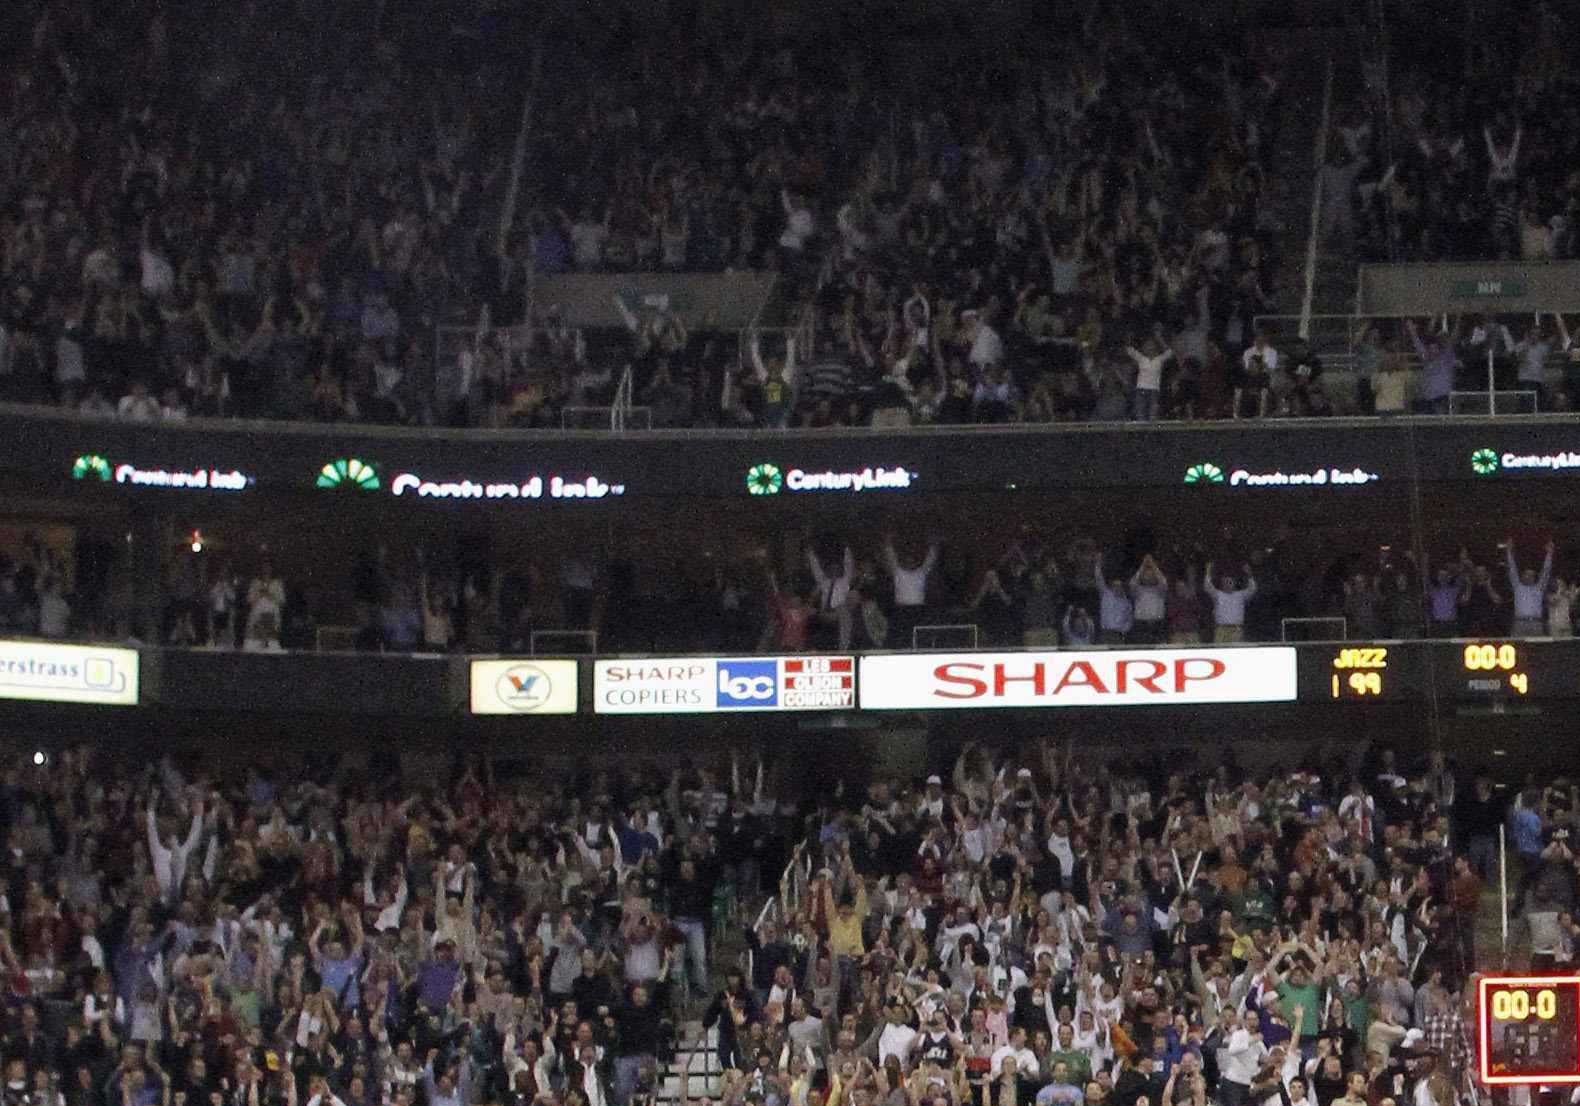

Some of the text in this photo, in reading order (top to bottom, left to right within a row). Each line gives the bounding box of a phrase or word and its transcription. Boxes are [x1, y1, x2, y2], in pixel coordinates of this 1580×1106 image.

[786, 467, 911, 491] CenturyLink
[1334, 648, 1387, 668] JAZZ
[606, 665, 706, 682] SHARP
[933, 657, 1226, 699] SHARP
[1350, 672, 1382, 695] 99
[605, 688, 703, 706] COPIERS
